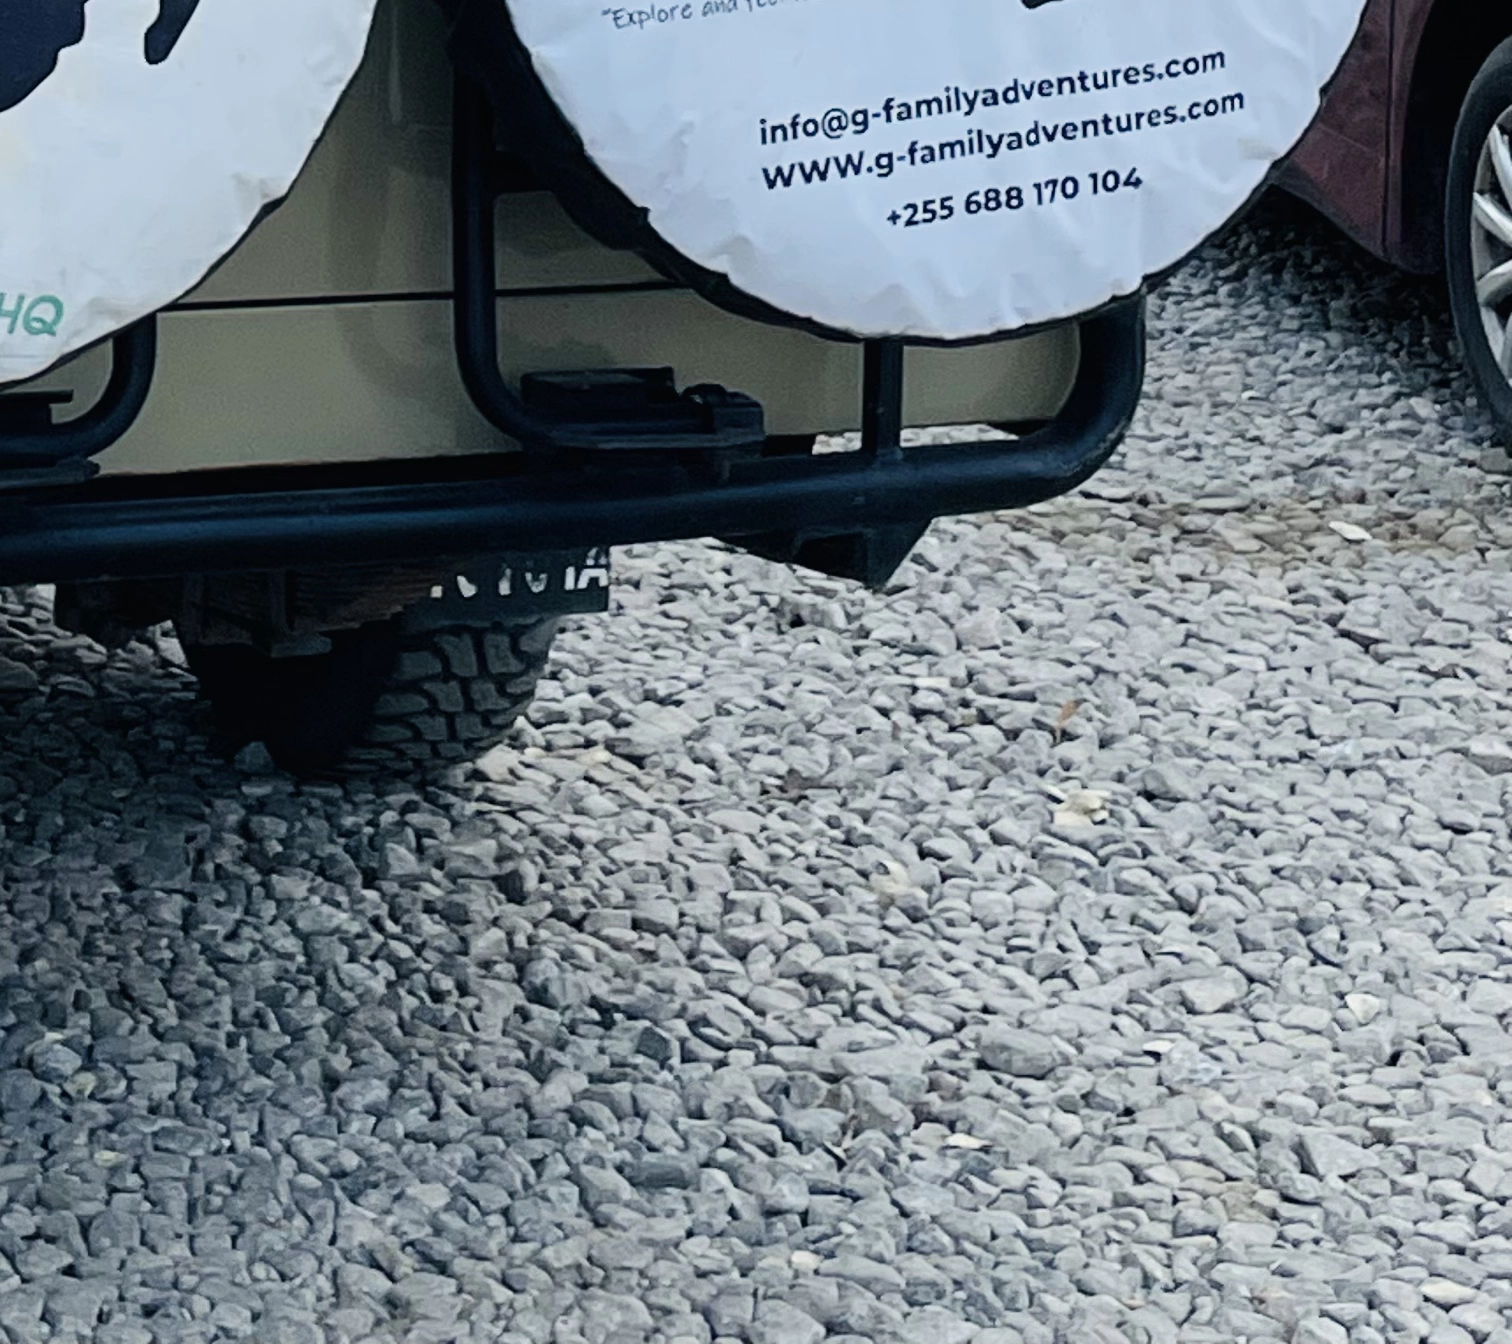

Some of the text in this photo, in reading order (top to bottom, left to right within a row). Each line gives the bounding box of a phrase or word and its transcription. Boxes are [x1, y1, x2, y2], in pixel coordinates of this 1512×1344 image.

[759, 49, 1226, 146] info@g-familyadventures.com
[886, 166, 1144, 228] +255 688 170 104
